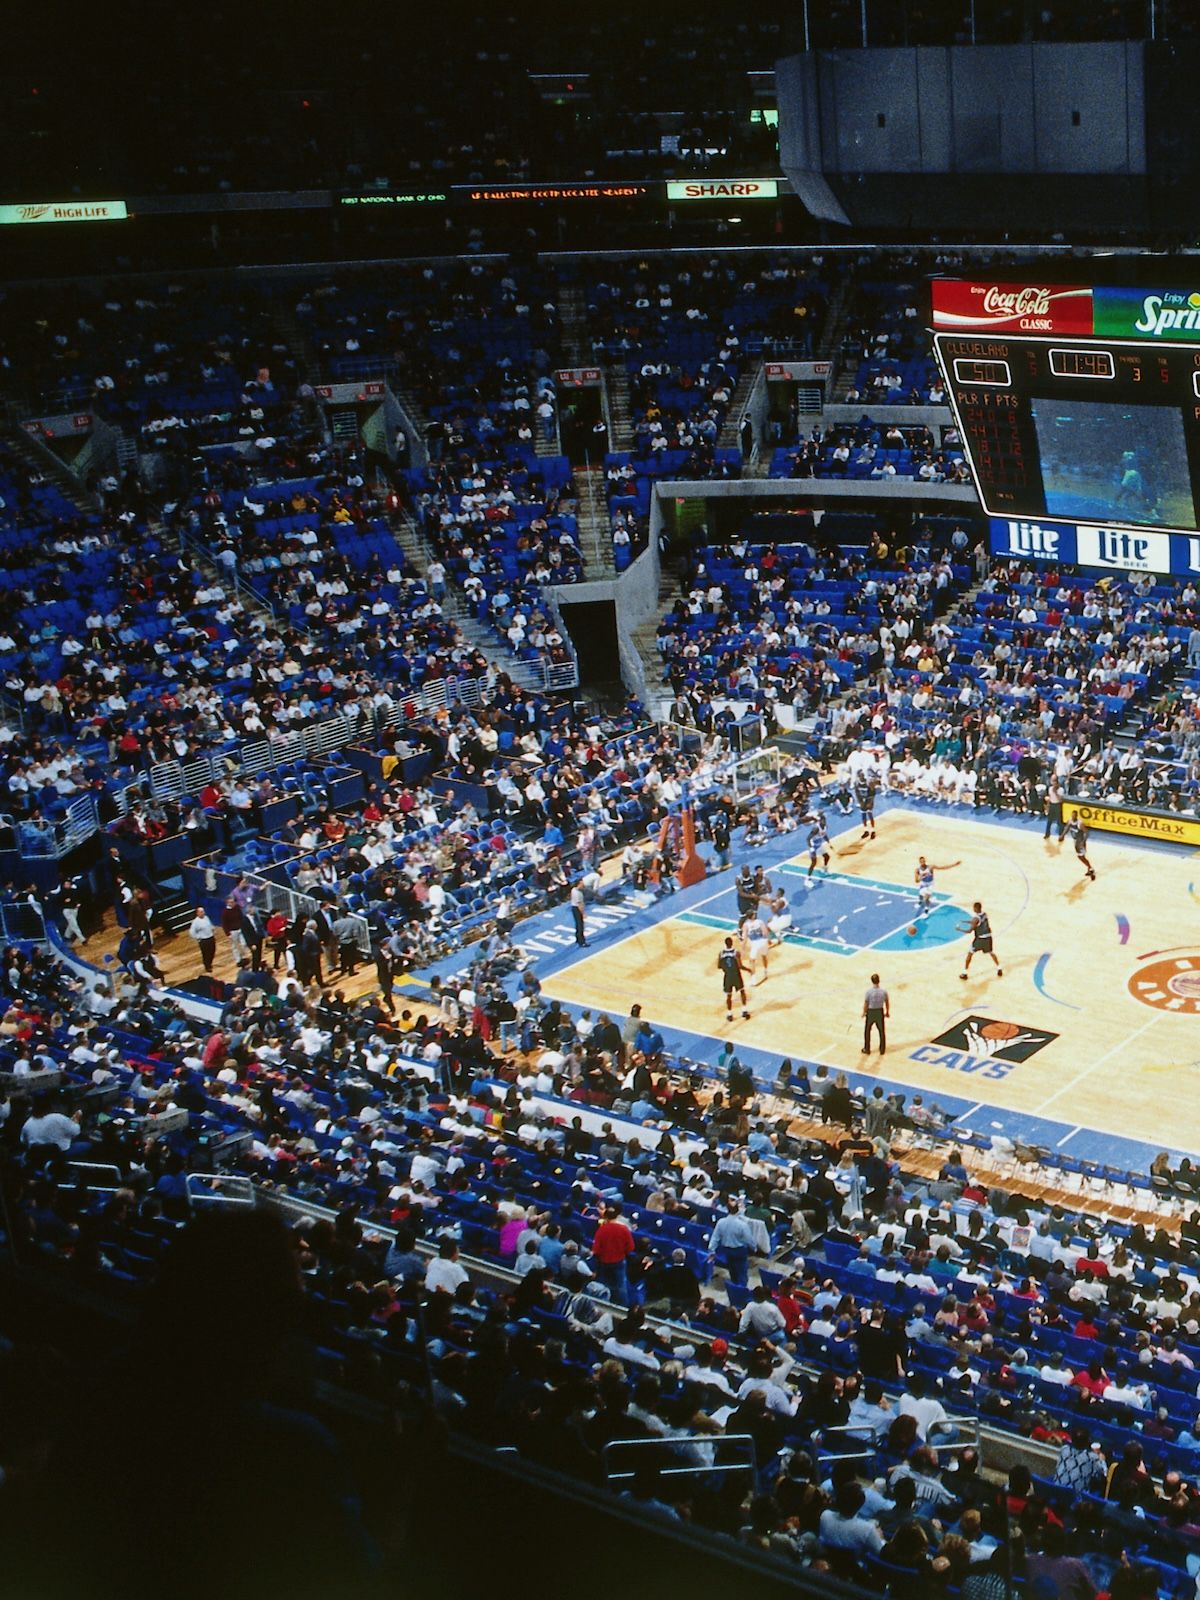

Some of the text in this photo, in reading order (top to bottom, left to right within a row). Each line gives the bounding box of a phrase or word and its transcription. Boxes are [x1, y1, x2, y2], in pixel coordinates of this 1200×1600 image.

[416, 194, 426, 202] OF
[685, 184, 759, 196] SHARP
[17, 206, 51, 220] Miller
[54, 207, 108, 218] HIGH LIFE
[970, 286, 986, 295] Enjoy
[1164, 292, 1186, 304] Enjoy
[984, 286, 1050, 315] Coca-Cola
[1020, 318, 1053, 331] CLASSIC
[946, 342, 1009, 358] CLEVELAND
[973, 362, 996, 382] 50
[1062, 354, 1108, 375] 11:46
[1132, 368, 1142, 382] 3
[1160, 368, 1169, 384] 5
[956, 392, 1019, 408] PLR F PTS
[1008, 522, 1060, 556] Lite
[1098, 530, 1149, 564] Lite
[1033, 550, 1059, 560] BEER
[1080, 807, 1184, 835] OfficeMax
[908, 1045, 1016, 1080] CAVS
